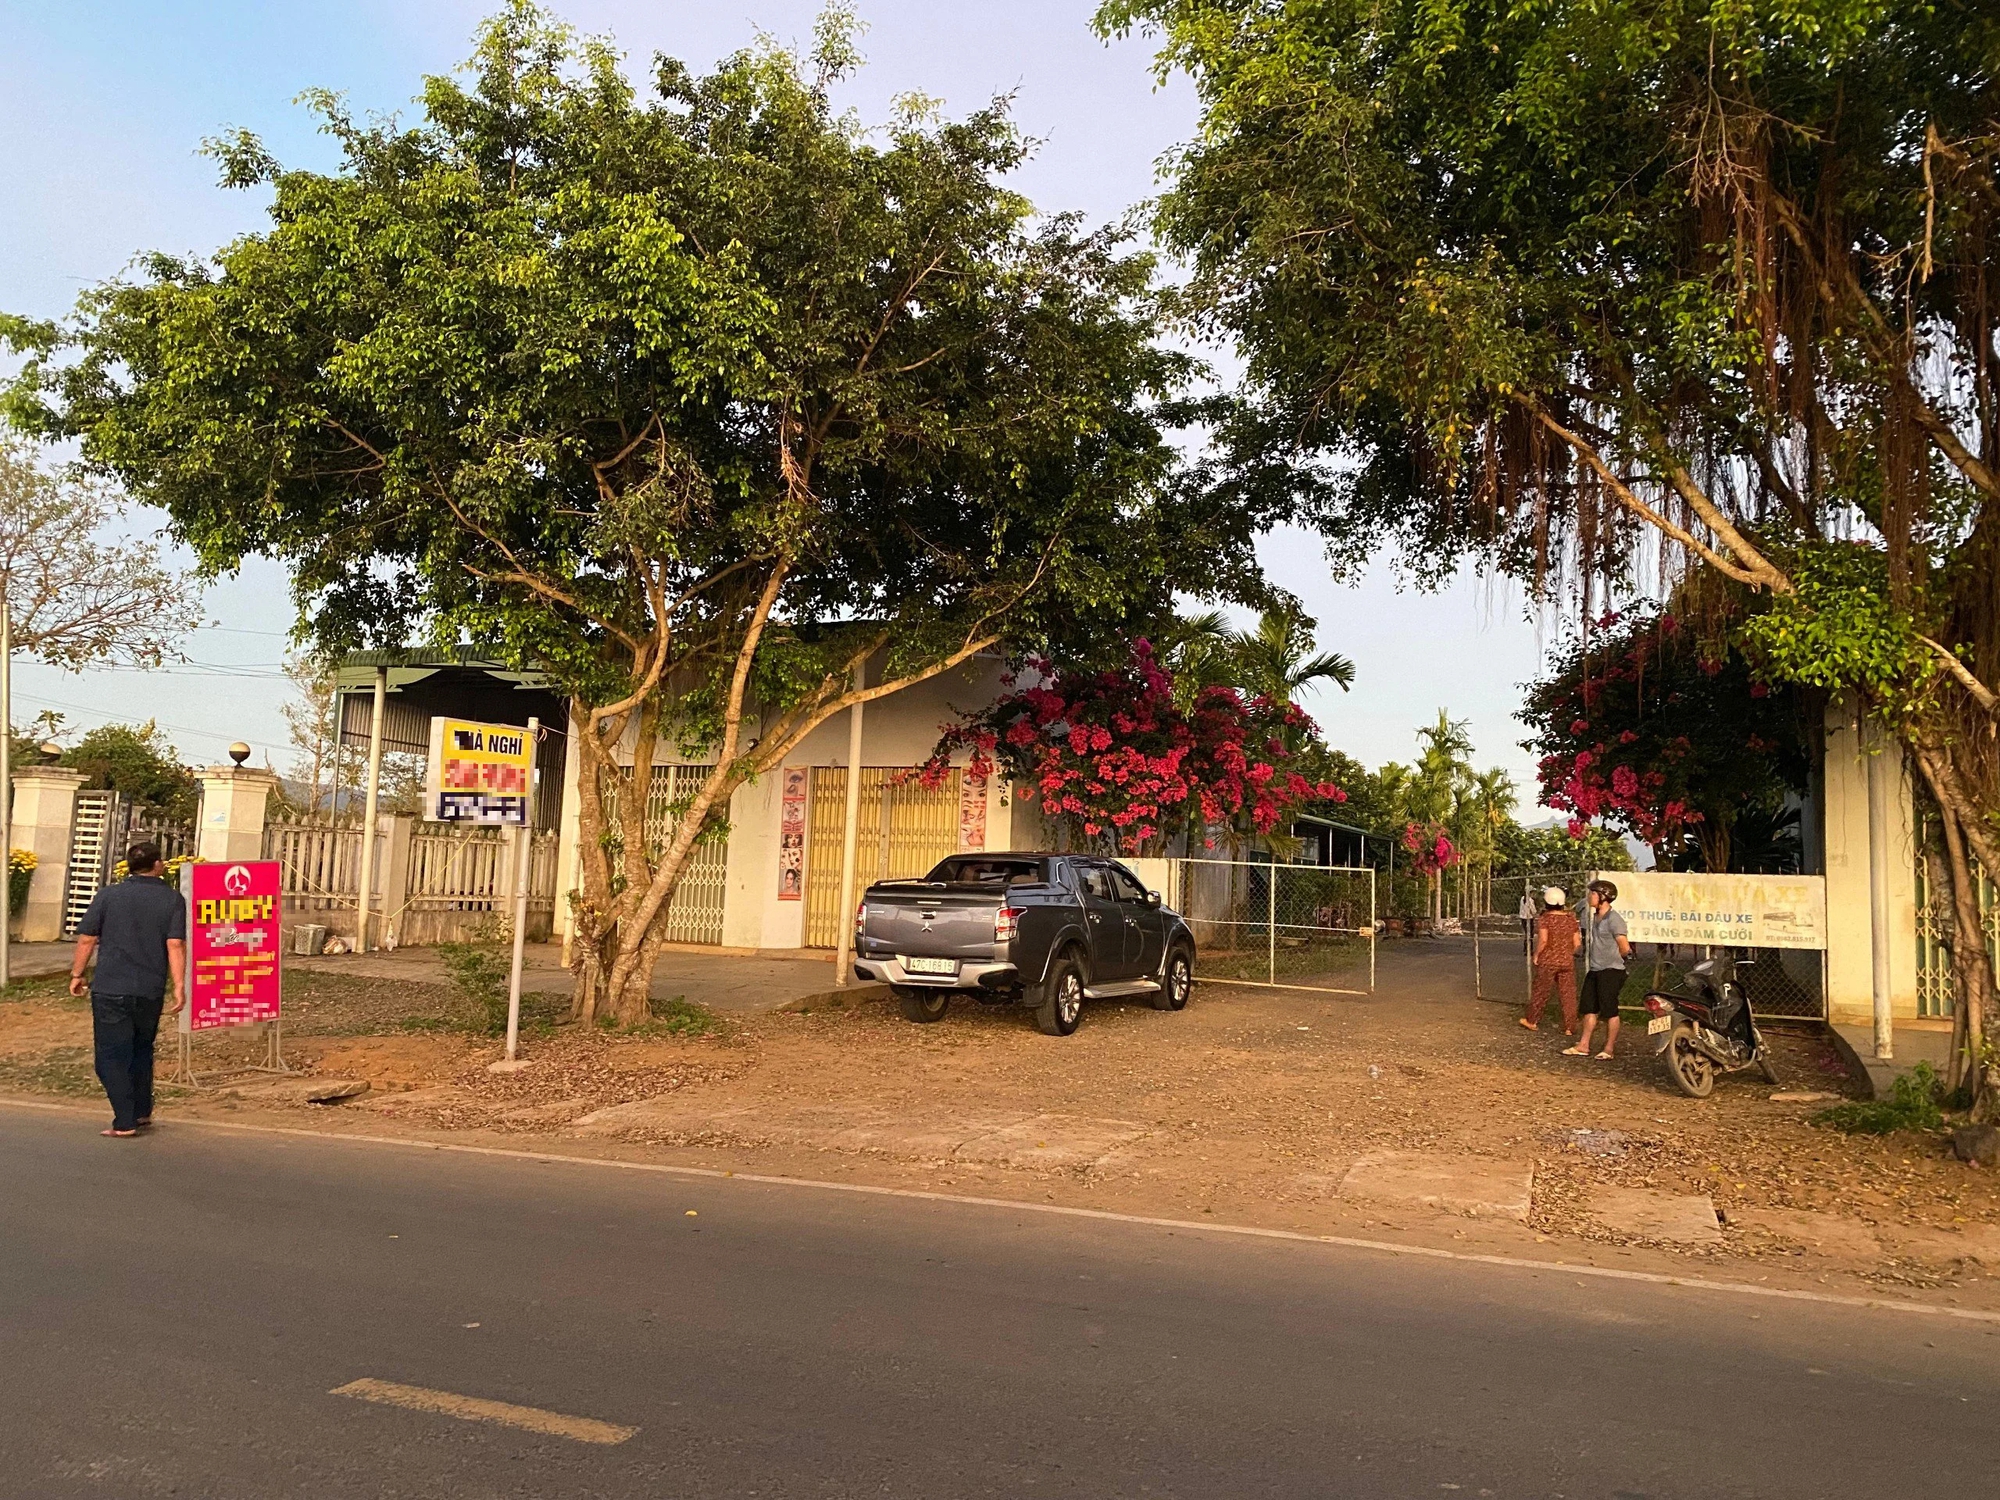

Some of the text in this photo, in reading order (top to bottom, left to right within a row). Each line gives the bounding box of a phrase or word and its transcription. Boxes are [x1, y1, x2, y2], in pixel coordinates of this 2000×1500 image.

[488, 732, 524, 756] NGHỈ
[1618, 910, 1635, 920] HO
[1735, 914, 1753, 924] XE
